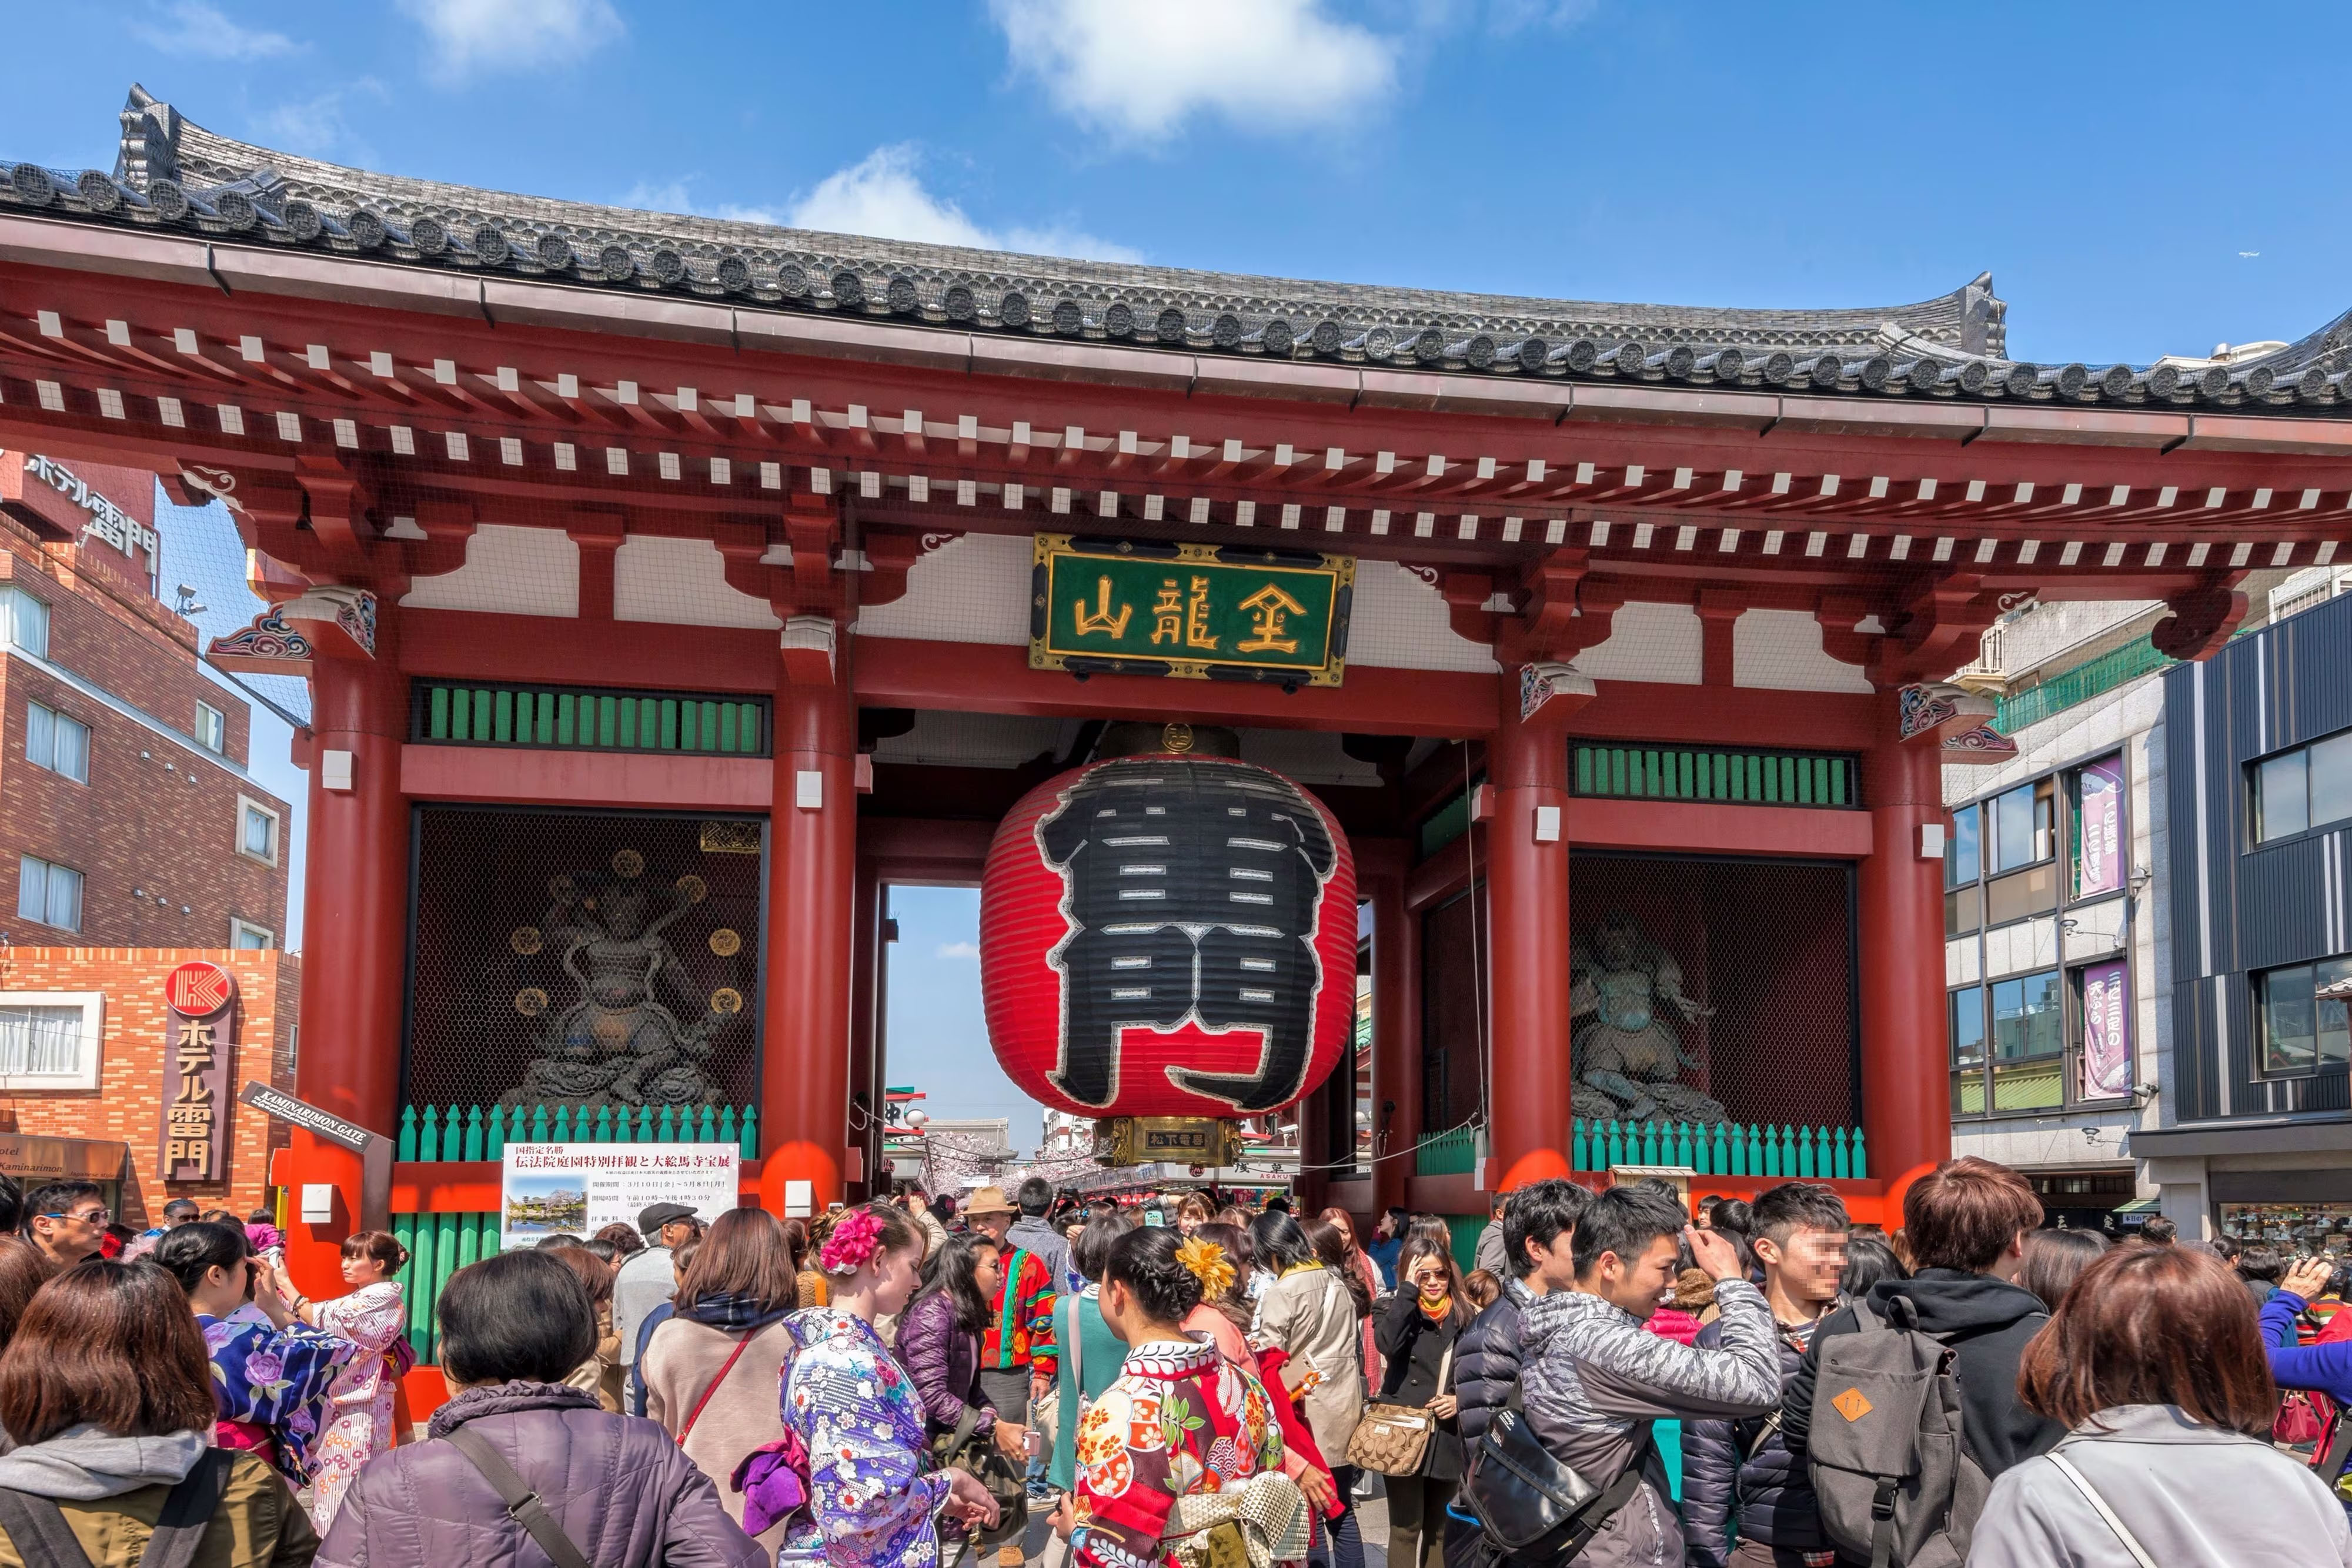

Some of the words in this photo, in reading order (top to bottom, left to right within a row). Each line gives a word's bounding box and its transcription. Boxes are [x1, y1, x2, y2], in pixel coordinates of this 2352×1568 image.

[34, 454, 158, 576] ホテル雷門
[1034, 757, 1338, 1112] 雷門
[165, 1020, 213, 1174] ホテル雷門
[260, 1091, 339, 1130] KAMINARIMON
[337, 1124, 367, 1141] GATE
[0, 1162, 62, 1172] Kaminarimon
[516, 1146, 564, 1154] 国指定名勝
[516, 1155, 730, 1168] 伝法院庭園特別拝観と大絵馬寺宝展
